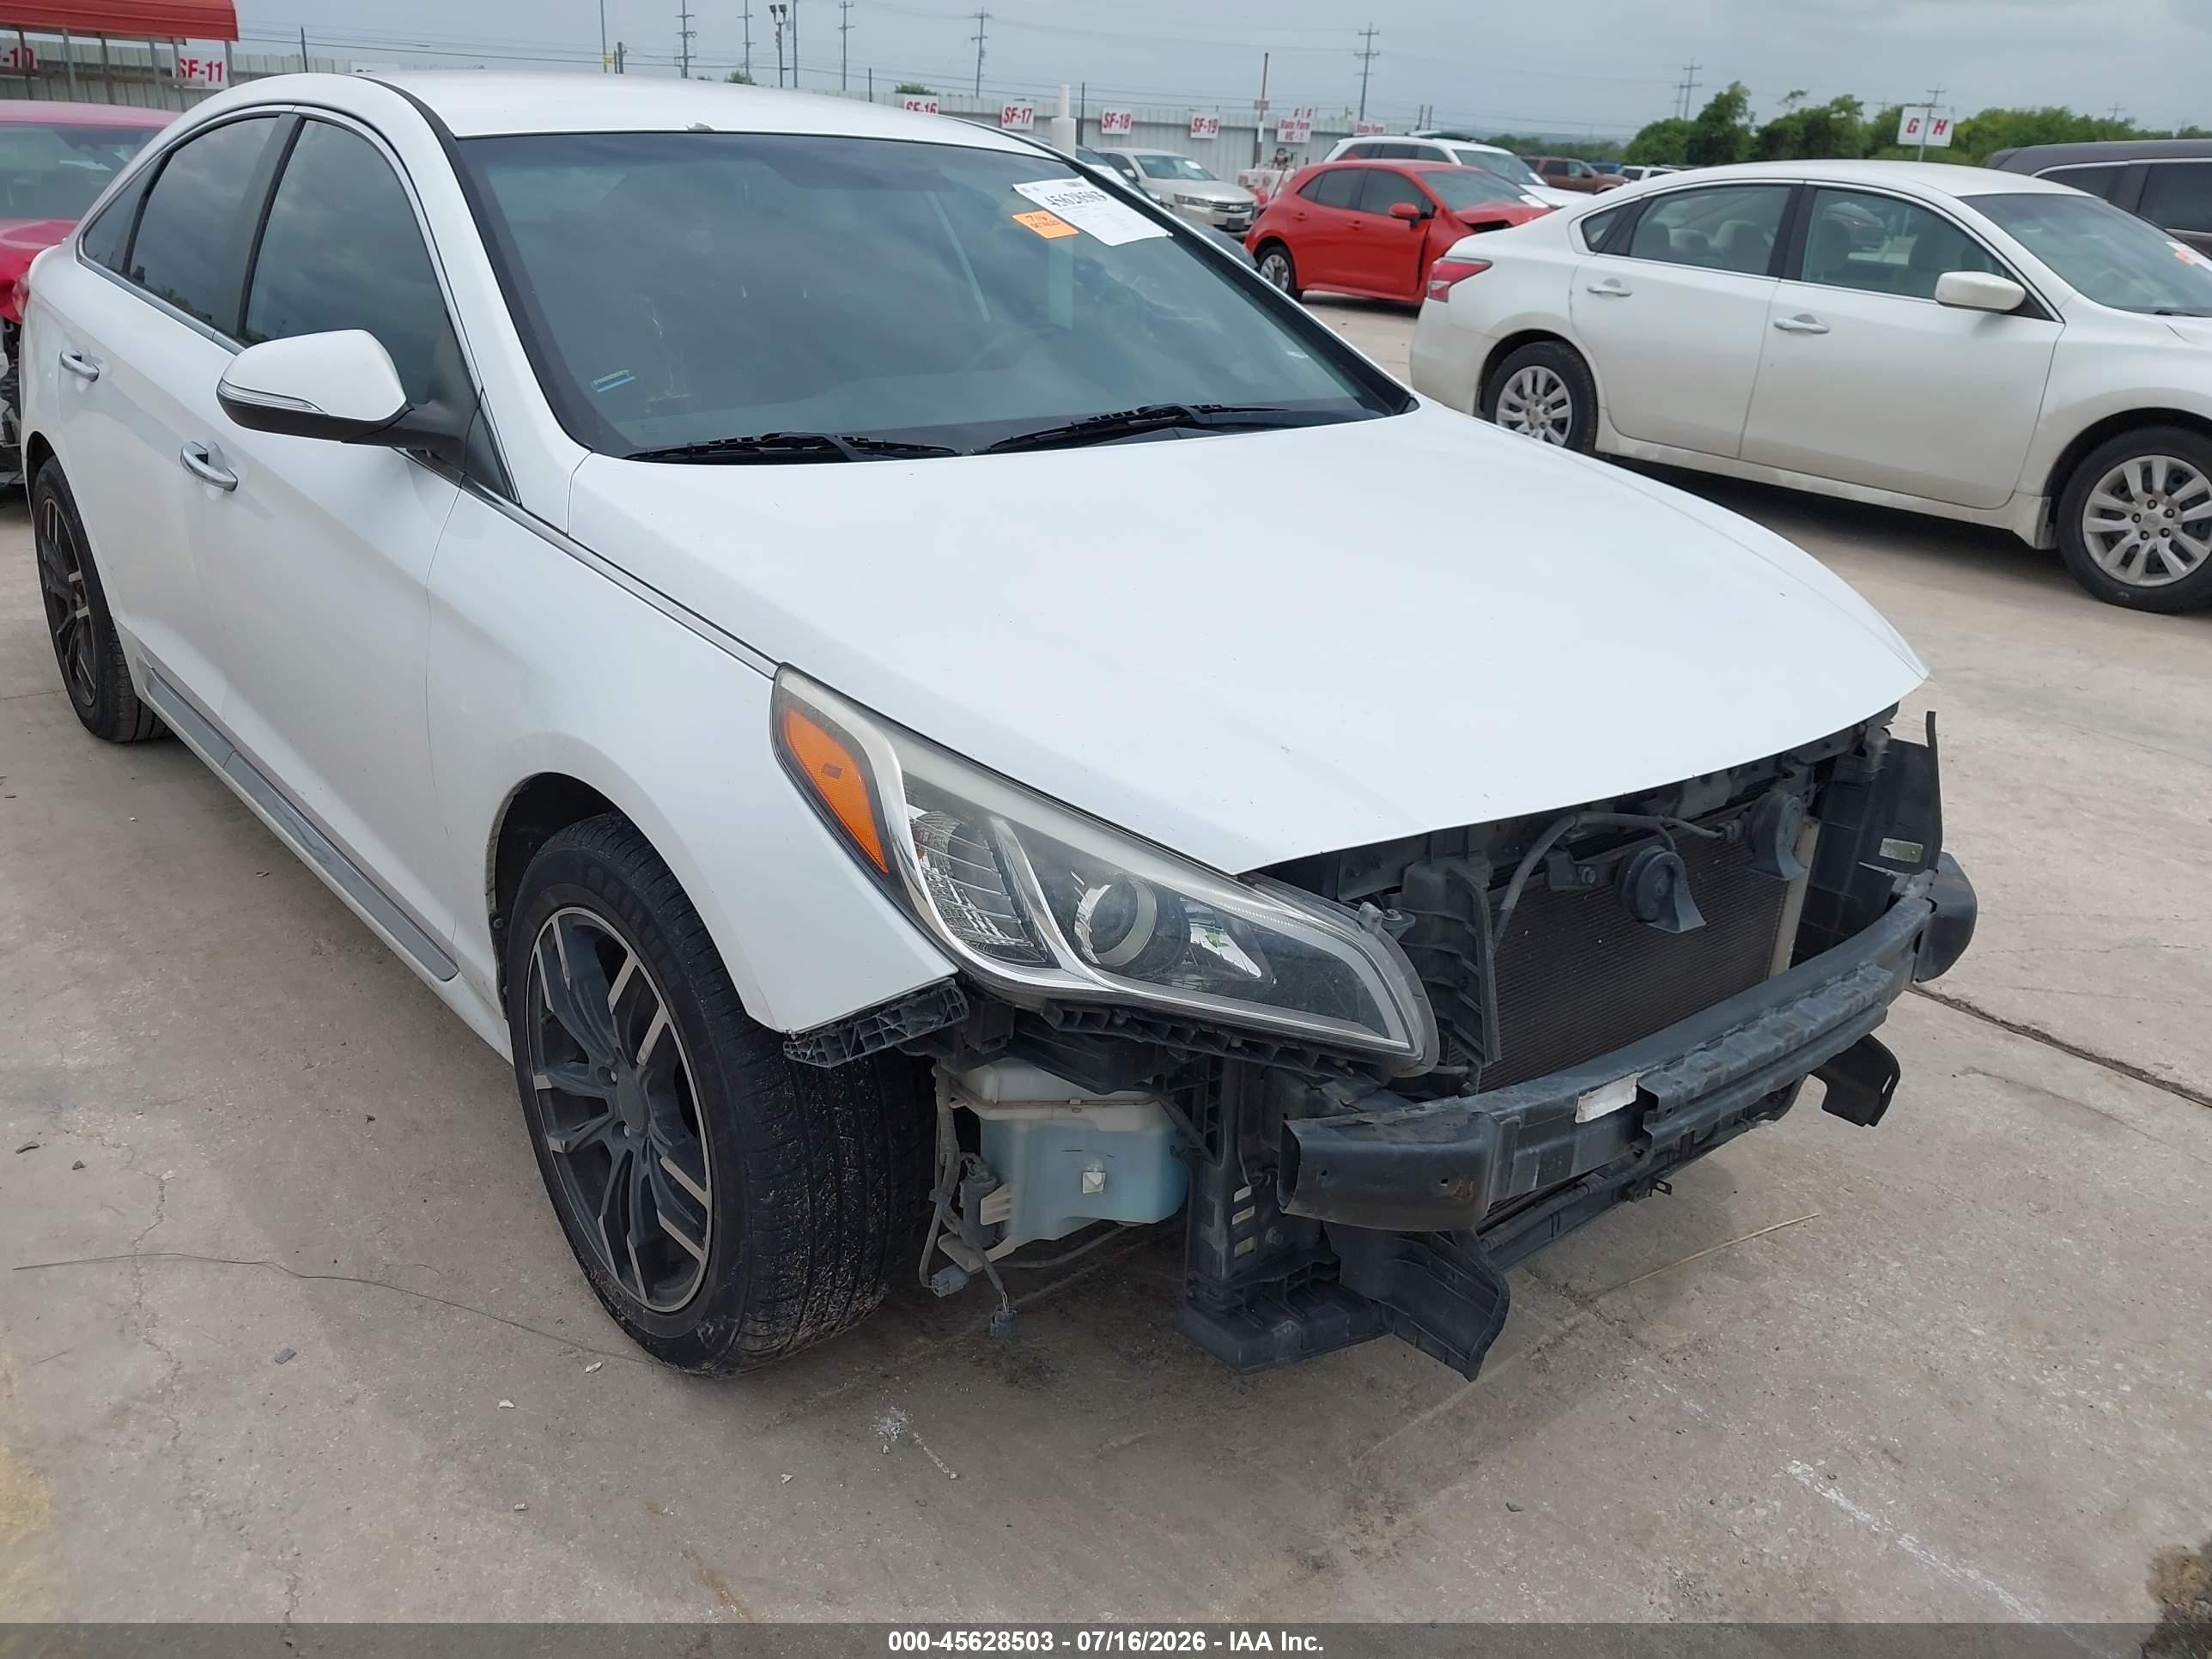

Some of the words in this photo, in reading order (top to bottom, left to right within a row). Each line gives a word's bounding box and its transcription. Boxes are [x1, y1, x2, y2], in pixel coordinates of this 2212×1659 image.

[178, 58, 223, 82] SF-11
[1003, 106, 1033, 125] SF-17
[1103, 112, 1131, 130] SF-18
[1192, 117, 1219, 134] SF-19
[1907, 118, 1920, 133] G
[1933, 119, 1948, 135] H
